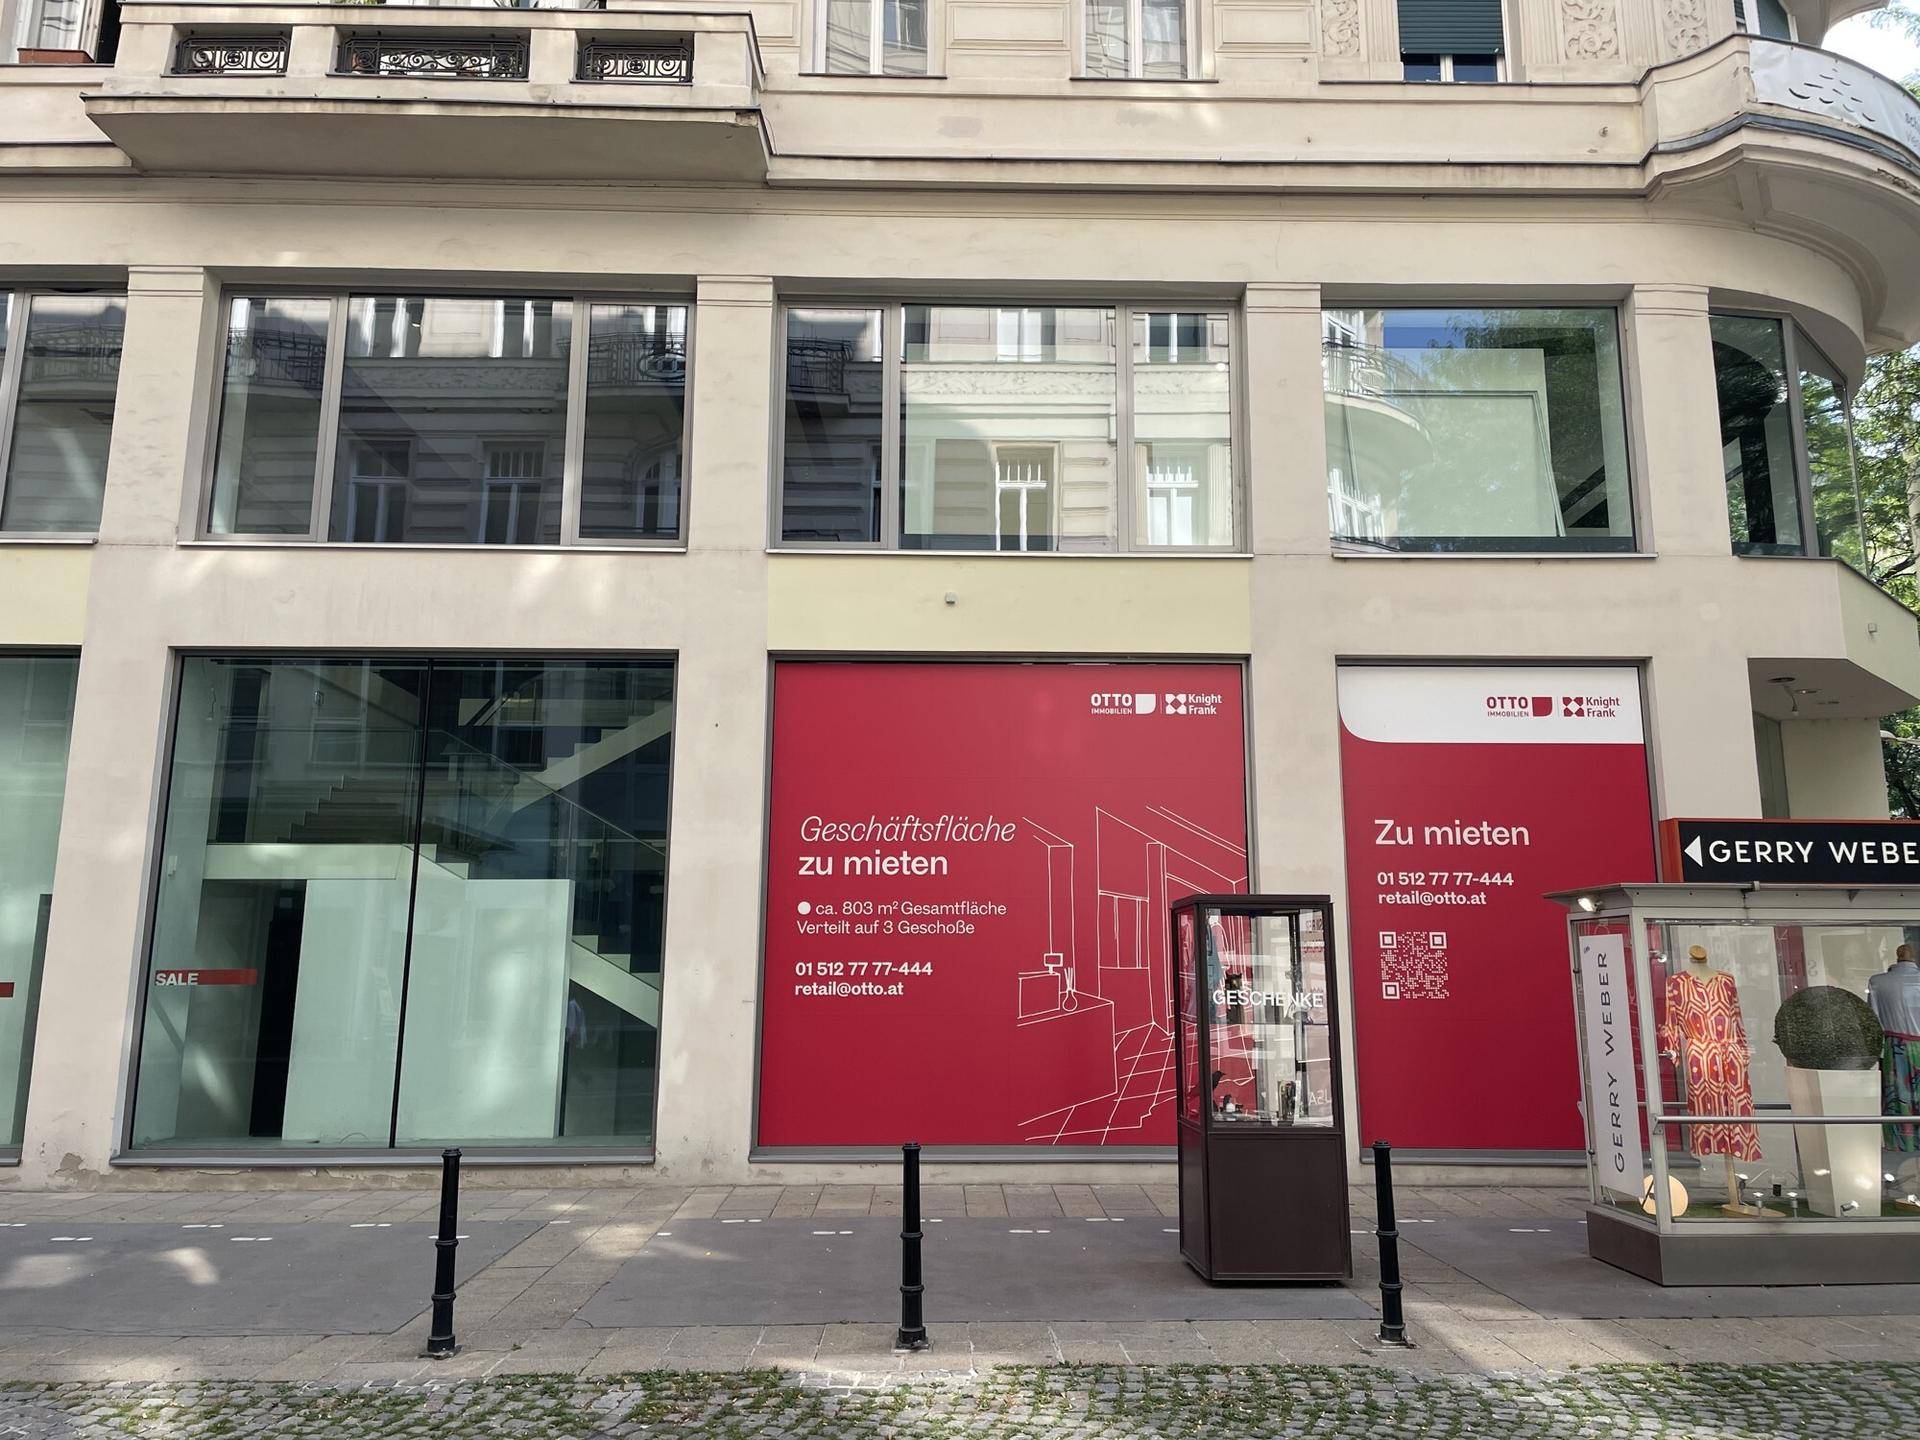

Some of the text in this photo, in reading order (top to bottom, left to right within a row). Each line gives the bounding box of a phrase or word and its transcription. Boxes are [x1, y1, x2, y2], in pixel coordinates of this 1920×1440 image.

[1091, 694, 1132, 706] OTTO
[1189, 694, 1222, 706] Knight
[1487, 697, 1528, 709] OTTO
[1586, 697, 1619, 708] Knight
[1189, 704, 1216, 714] Frank
[1587, 707, 1615, 717] Frank
[801, 815, 1015, 841] Geschäftsfläche
[1375, 820, 1529, 845] Zu mieten
[1709, 841, 1813, 863] GERRY
[799, 850, 947, 875] zu mieten
[1378, 872, 1514, 885] 01 512 77 77-444
[1379, 891, 1486, 905] retail@otto.at
[816, 901, 1006, 915] ca. 803 m² Gesamtfläche
[797, 920, 974, 934] Verteilt auf 3 Geschoße
[796, 962, 933, 975] 01 512 77 77-444
[155, 973, 199, 986] SALE
[795, 981, 903, 997] retail@otto.at
[1213, 989, 1324, 1008] GESCHENKE
[1598, 953, 1625, 1173] GERRY WEBER
